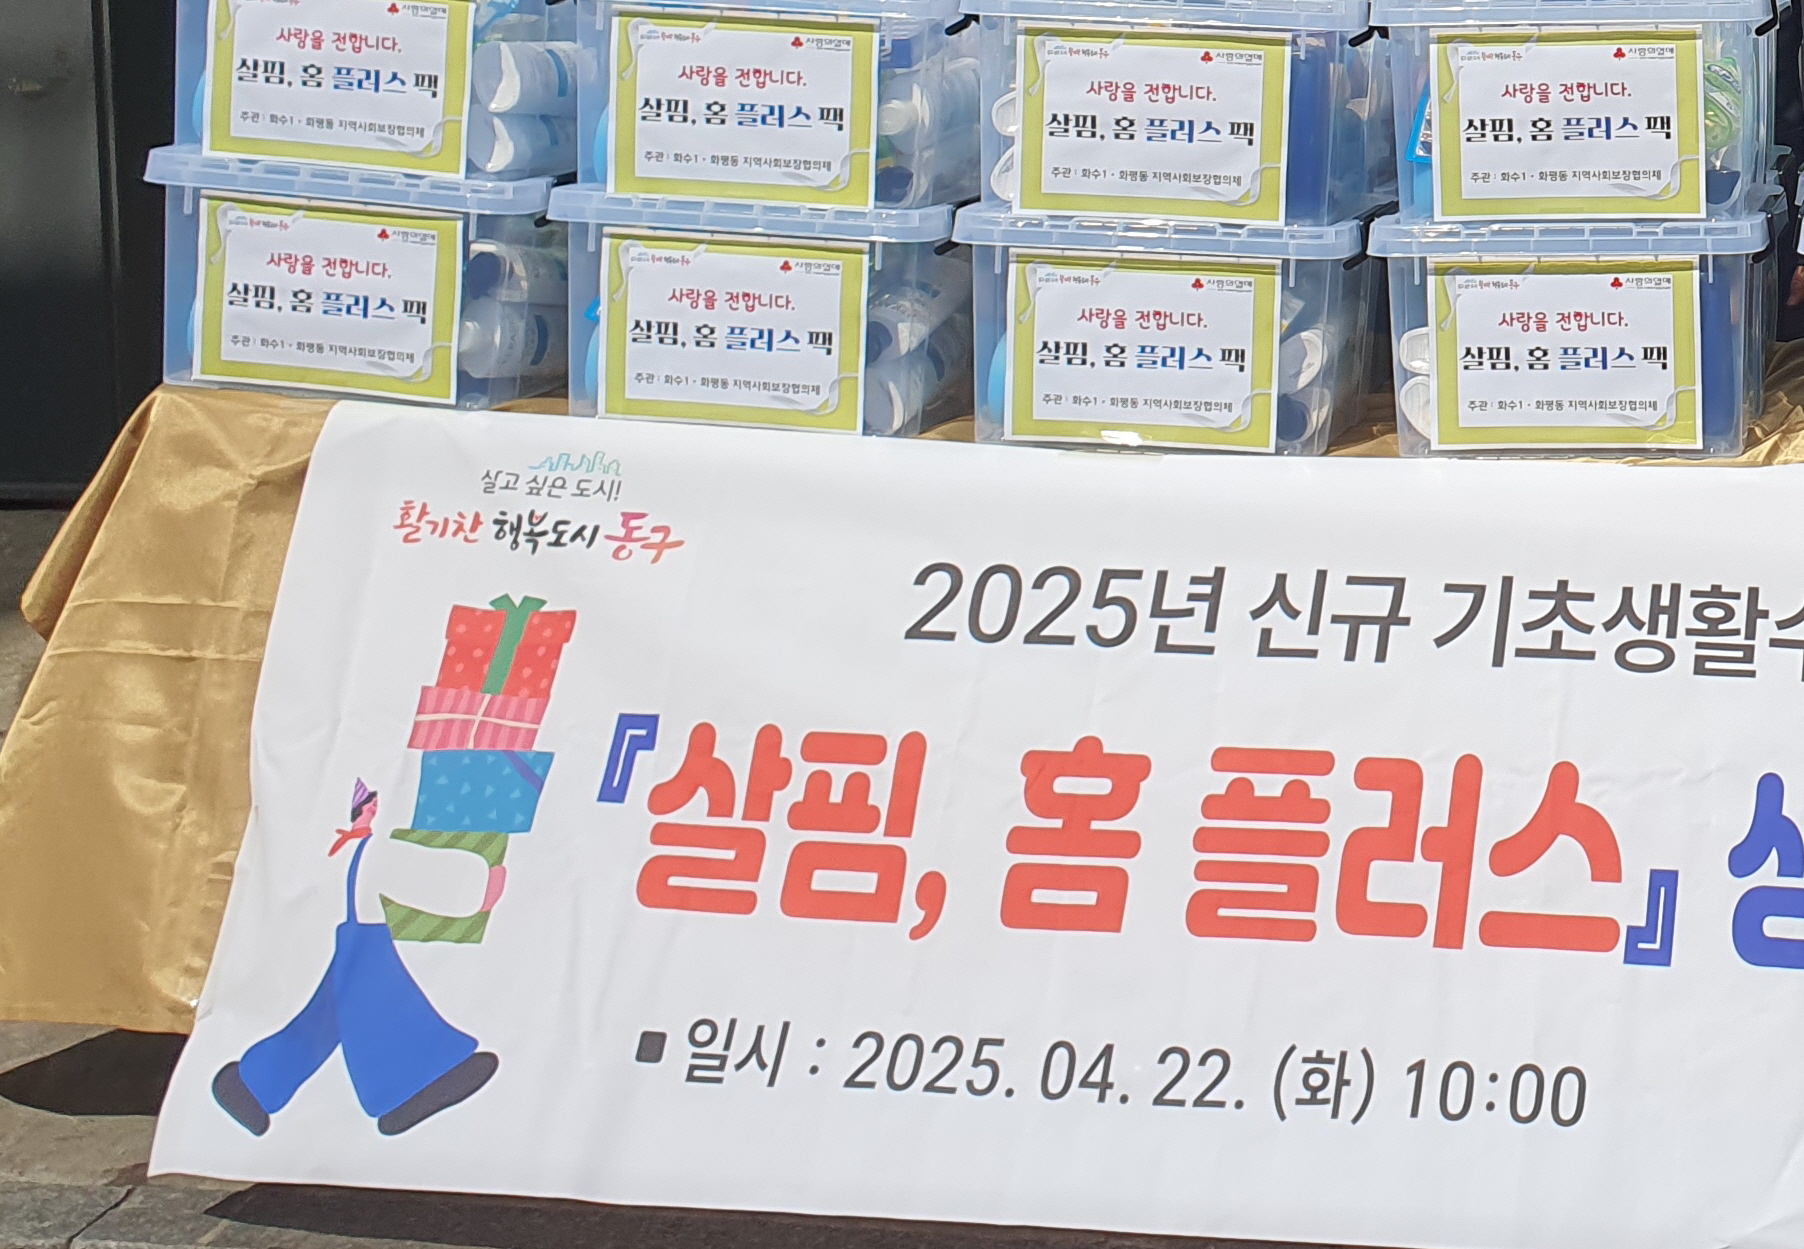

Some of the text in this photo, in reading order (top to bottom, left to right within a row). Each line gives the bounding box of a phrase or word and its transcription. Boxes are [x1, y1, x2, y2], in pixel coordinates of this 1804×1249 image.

[275, 27, 402, 53] 사랑을 전합니다.
[235, 57, 438, 99] 살핌, 홈 플러스 팩
[678, 65, 807, 88] 사랑을 전합니다.
[1086, 80, 1217, 104] 사랑을 전합니다.
[1501, 81, 1632, 104] 사랑을 전합니다.
[638, 97, 844, 132] 살핌, 홈 플러스 팩
[1046, 113, 1255, 146] 살핌, 홈 플러스 팩
[1462, 115, 1672, 145] 살핌, 홈 플러스 팩
[1051, 167, 1072, 178] 주관
[265, 252, 392, 279] 사랑을 전합니다.
[226, 282, 427, 325] 살핌, 홈 플러스 팩
[668, 287, 796, 312] 사랑을 전합니다.
[1077, 307, 1208, 330] 사랑을 전합니다.
[1498, 310, 1629, 333] 사랑을 전합니다.
[629, 319, 833, 356] 살핌, 홈 플러스 팩
[1036, 340, 1245, 373] 살핌, 홈 플러스 팩
[1460, 346, 1668, 373] 살핌, 홈 플러스 팩
[481, 470, 622, 502] 살고 싶은 도시!
[394, 500, 684, 564] 활기찬 행복도시 동구
[904, 562, 1226, 655] 2025년
[1249, 569, 1411, 663] 신규
[597, 713, 946, 940] 『살핌,
[1000, 736, 1152, 933] 홈
[1186, 747, 1679, 967] 플러스』
[685, 1018, 791, 1087] 일시
[843, 1031, 1014, 1098] 2025.
[1041, 1040, 1129, 1104] 04.
[1152, 1046, 1244, 1109] 22.
[1274, 1044, 1374, 1125] (화)
[1406, 1059, 1586, 1127] 10:00
